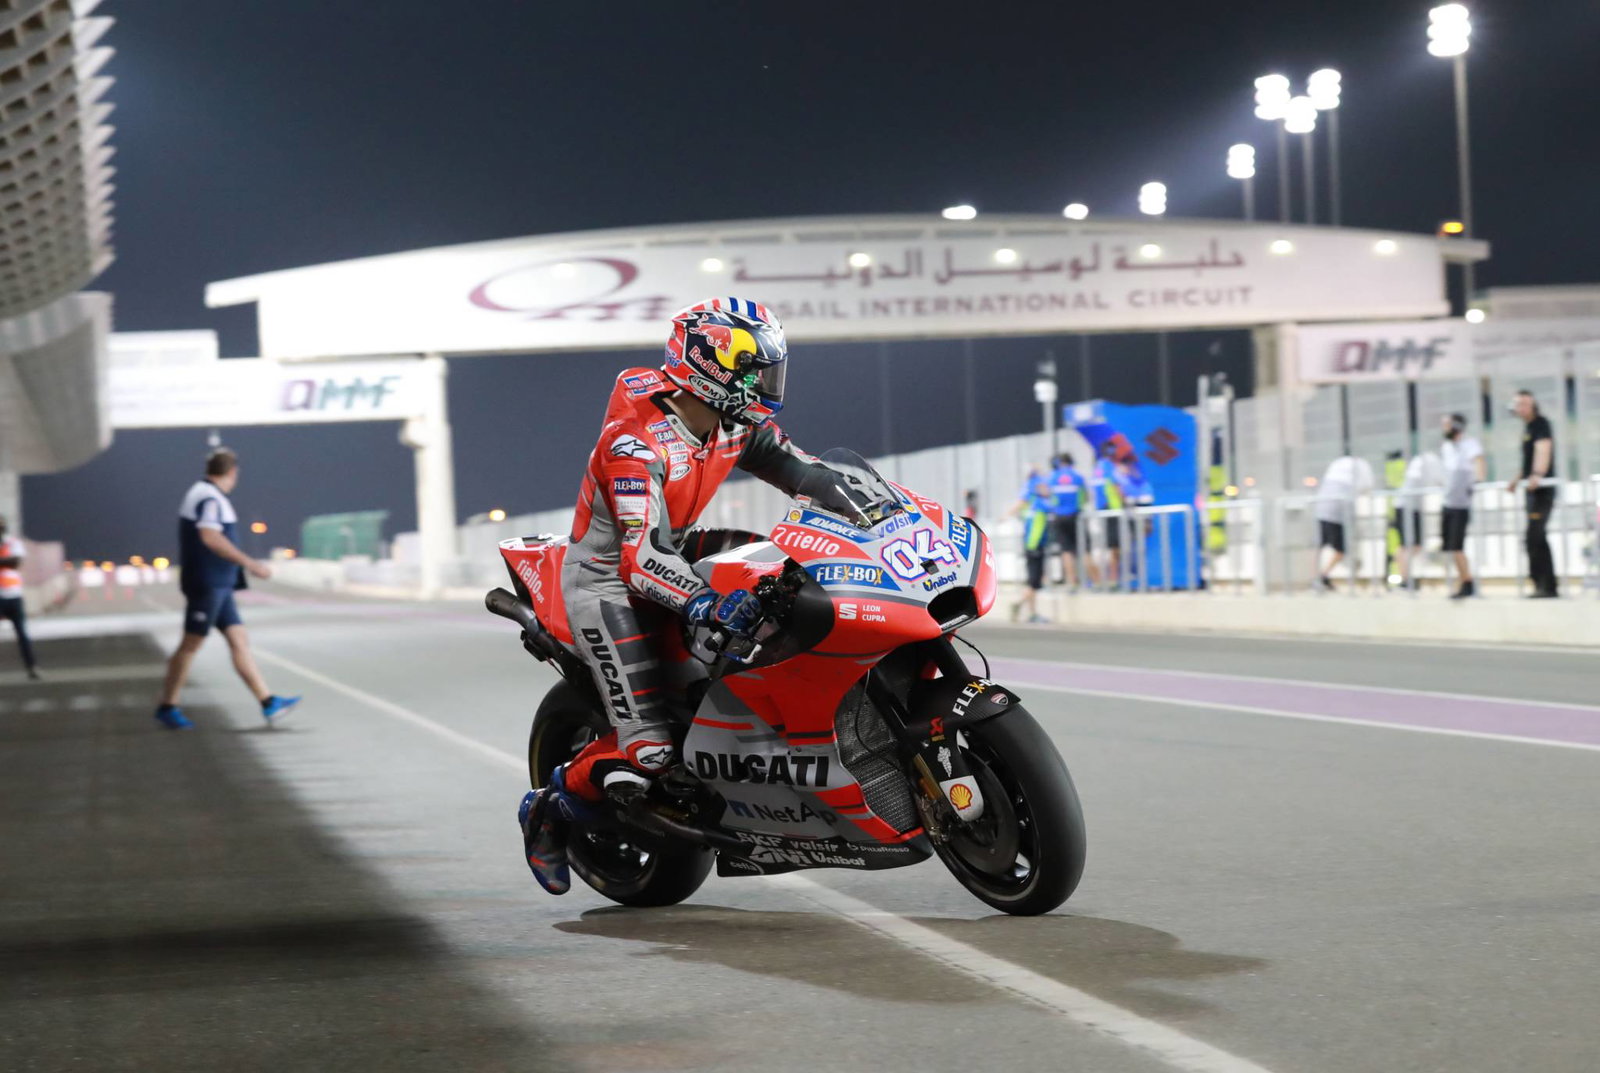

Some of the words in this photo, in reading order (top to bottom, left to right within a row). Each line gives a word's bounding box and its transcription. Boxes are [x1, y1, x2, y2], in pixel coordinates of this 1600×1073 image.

[859, 289, 1110, 318] INTERNATIONAL
[1127, 285, 1253, 309] CIRCUIT
[688, 345, 713, 371] Red
[707, 362, 733, 385] Bull
[692, 376, 726, 399] SUOMY
[805, 516, 861, 538] ADVANCE
[784, 531, 841, 556] riello
[880, 529, 958, 581] 04
[516, 559, 542, 594] riello
[643, 558, 700, 592] DUCATI
[816, 564, 884, 586] FLEX-BOX
[922, 572, 957, 592] Unibat
[862, 604, 881, 612] LEON
[862, 614, 886, 622] CUPRA
[581, 628, 634, 720] DUCATI
[695, 751, 830, 787] DUCATI
[735, 831, 782, 847] SKF
[790, 840, 838, 852] valsir
[811, 851, 866, 866] Unibat
